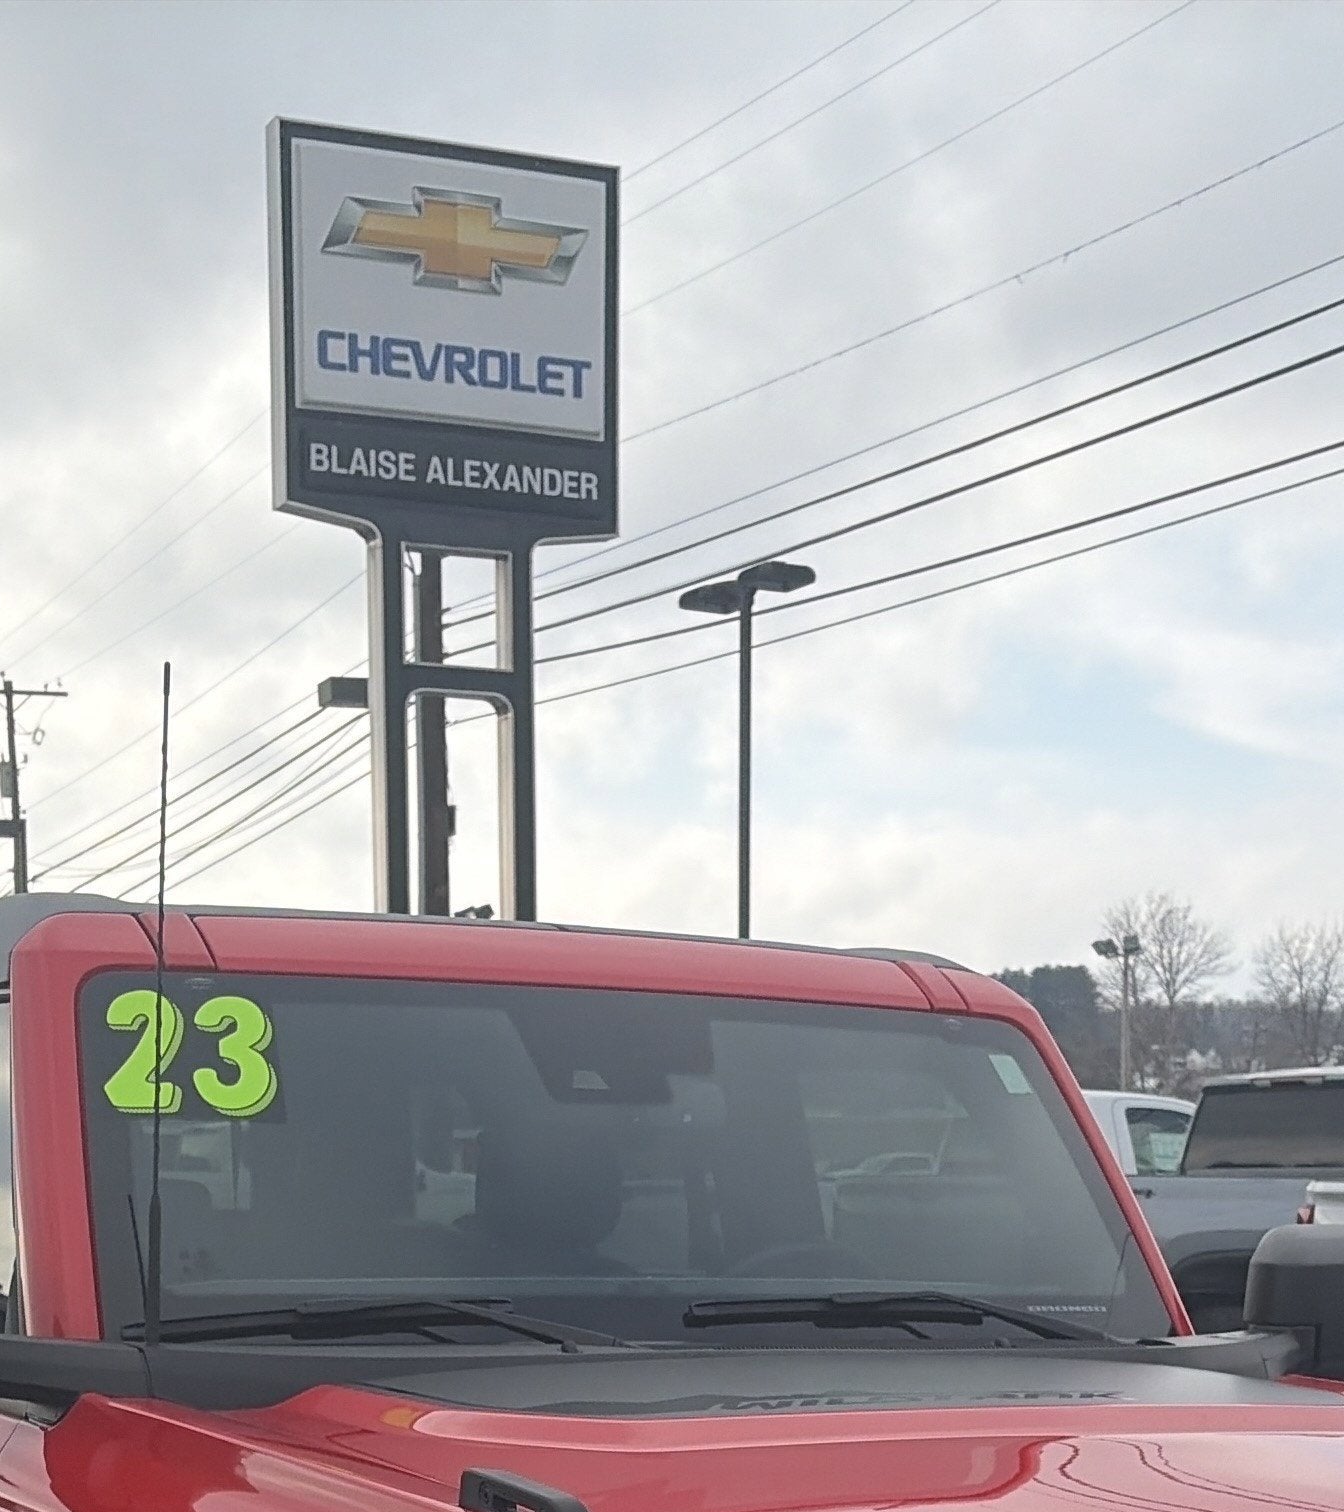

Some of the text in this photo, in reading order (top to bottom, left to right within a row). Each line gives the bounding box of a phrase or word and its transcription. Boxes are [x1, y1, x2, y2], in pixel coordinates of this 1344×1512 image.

[317, 329, 592, 399] CHEVROLET
[309, 442, 599, 500] BLAISE ALEXANDER
[104, 989, 278, 1117] 23
